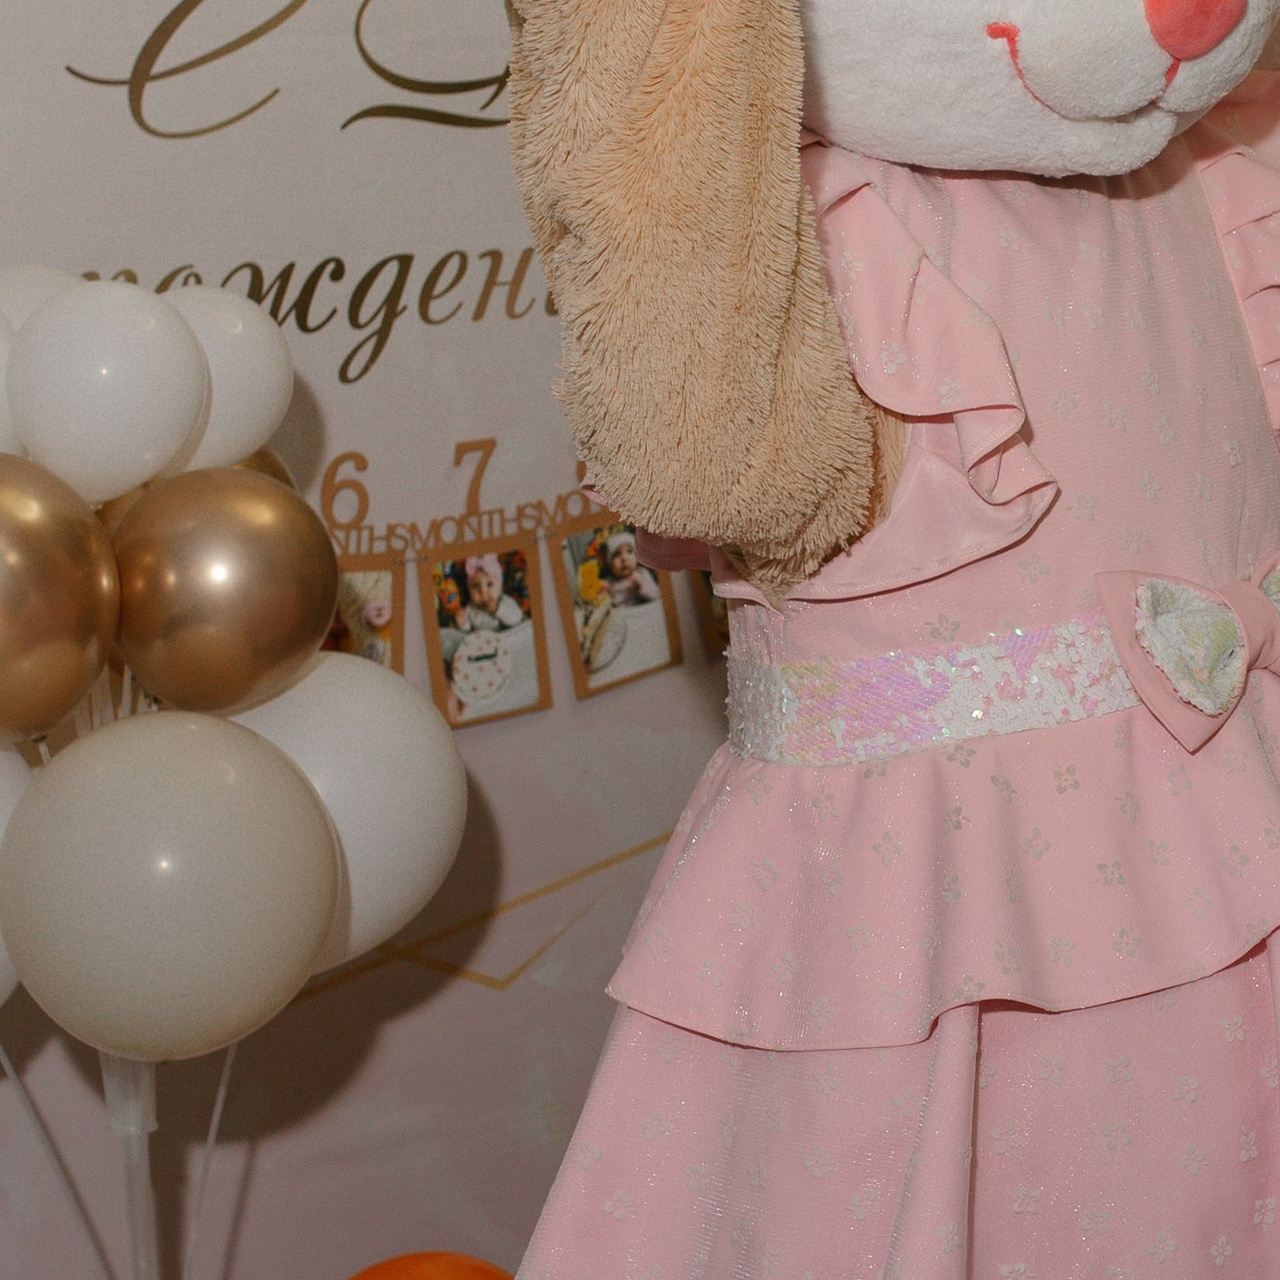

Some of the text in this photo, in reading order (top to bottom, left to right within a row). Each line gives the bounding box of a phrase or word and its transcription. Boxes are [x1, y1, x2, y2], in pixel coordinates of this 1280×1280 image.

[321, 451, 369, 527] 6
[454, 437, 497, 515] 7
[328, 522, 408, 557] NTHS
[409, 503, 537, 551] MONTHS
